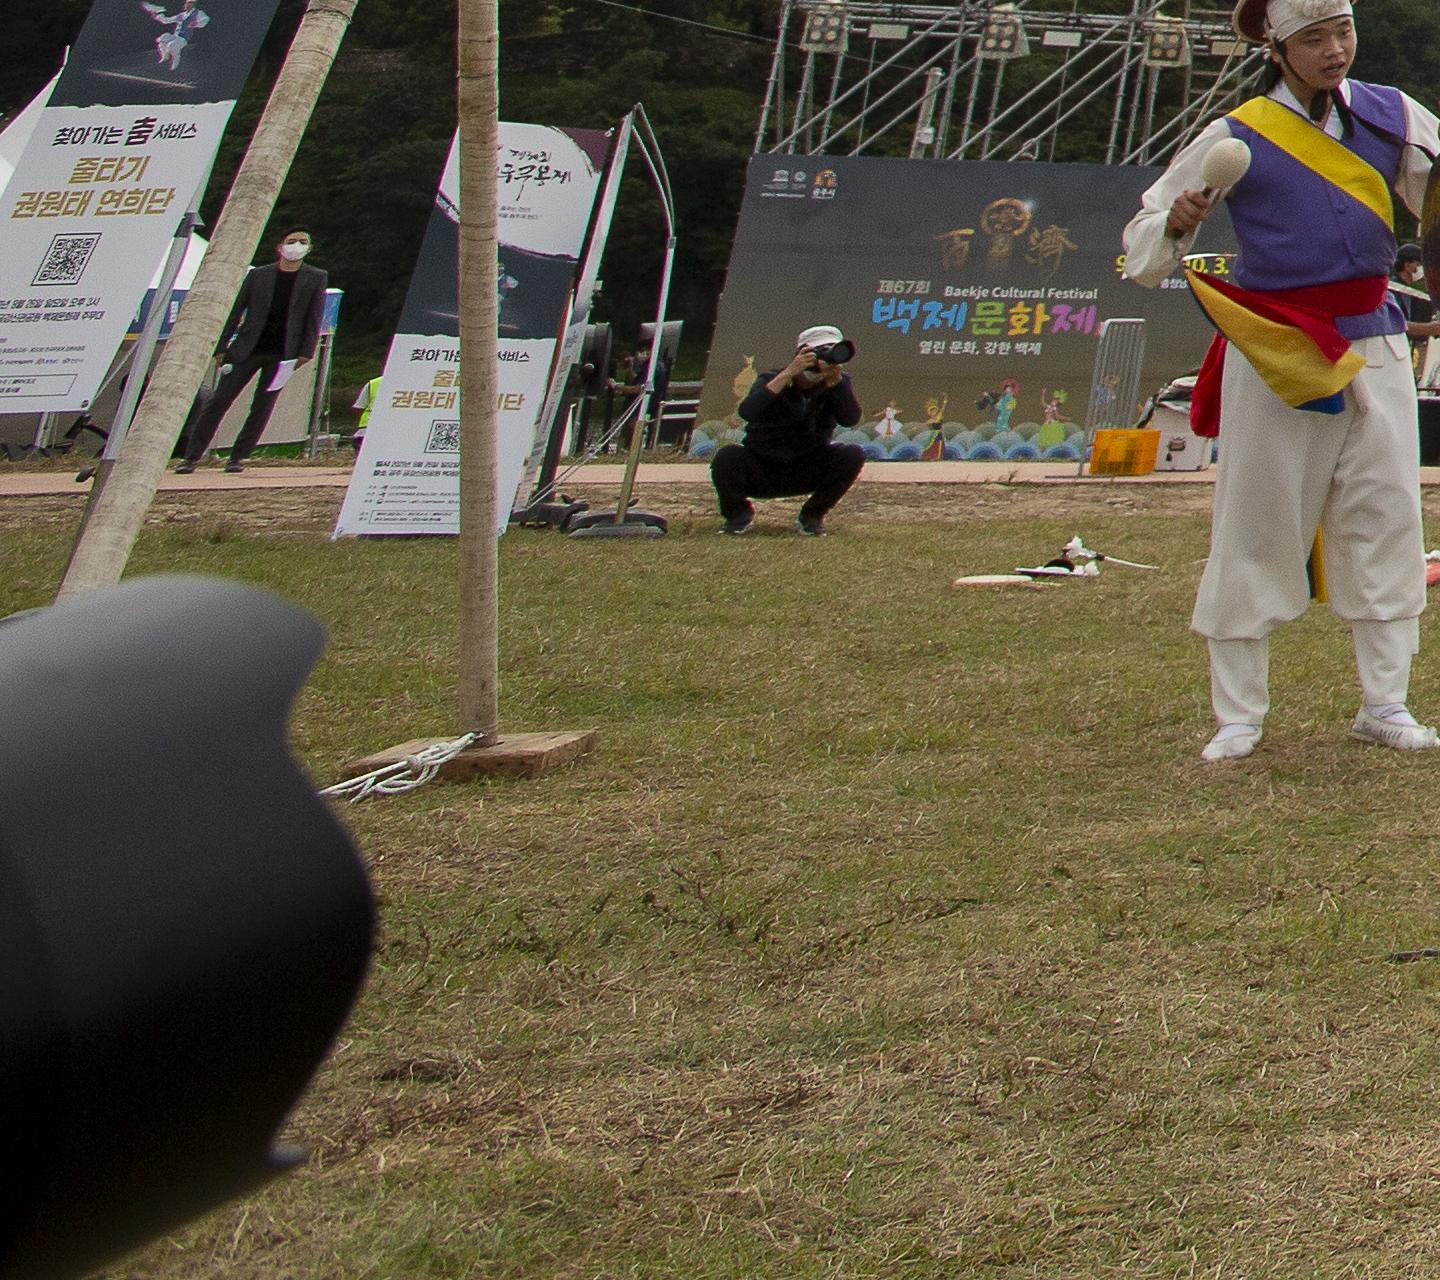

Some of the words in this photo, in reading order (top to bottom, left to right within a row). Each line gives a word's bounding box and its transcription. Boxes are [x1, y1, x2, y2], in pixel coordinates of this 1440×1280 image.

[52, 125, 124, 146] 찾아가는
[124, 116, 158, 146] 춤
[153, 123, 198, 140] 서비스
[68, 156, 151, 184] 줄타기
[10, 189, 95, 219] 권원태
[95, 187, 176, 216] 연희단
[944, 285, 988, 300] Baekje
[992, 287, 1044, 299] Cultural
[1047, 288, 1098, 300] Festival
[871, 297, 1097, 336] 백제문화제
[919, 341, 945, 355] 열린
[984, 342, 1011, 356] 강한
[1014, 342, 1041, 356] 백제
[391, 390, 457, 410] 권원태
